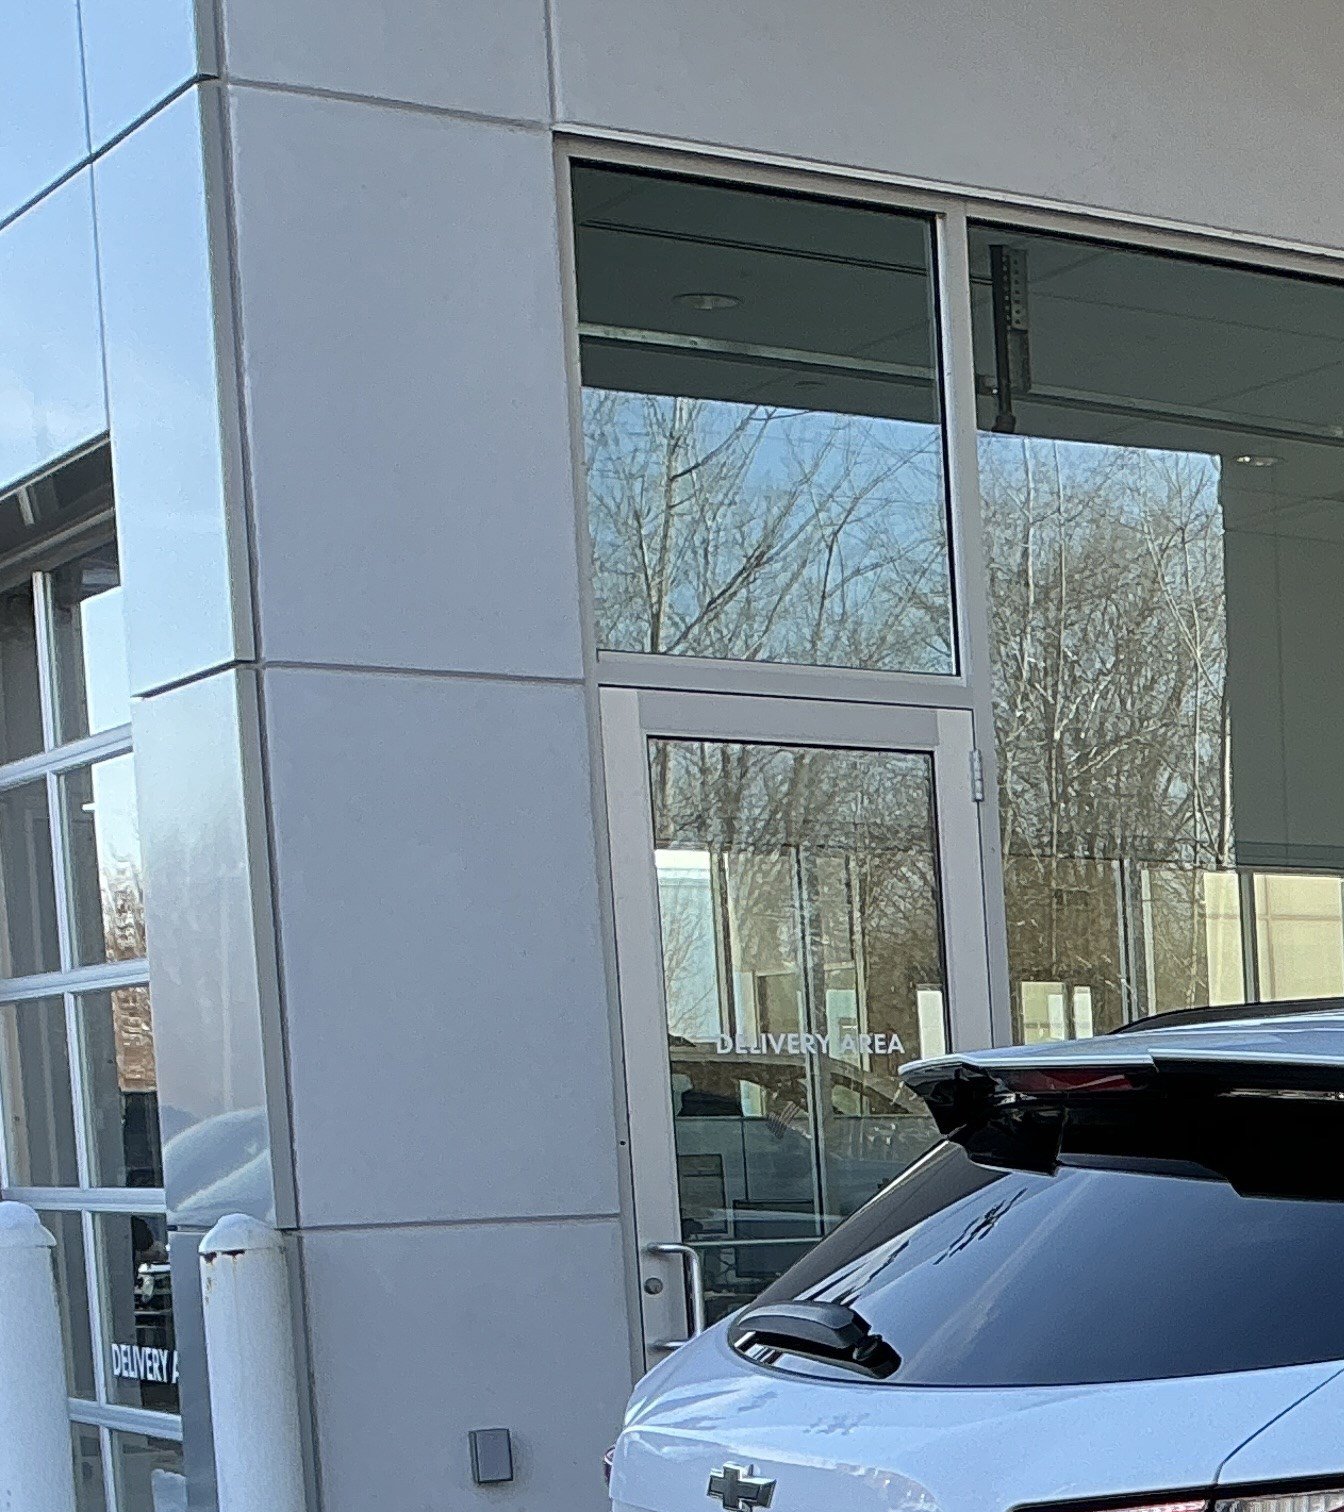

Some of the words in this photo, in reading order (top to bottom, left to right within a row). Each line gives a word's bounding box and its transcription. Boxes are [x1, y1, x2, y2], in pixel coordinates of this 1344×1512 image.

[716, 1033, 829, 1055] DELIVERY
[841, 1033, 906, 1055] AREA
[111, 1343, 168, 1383] DELIVERY
